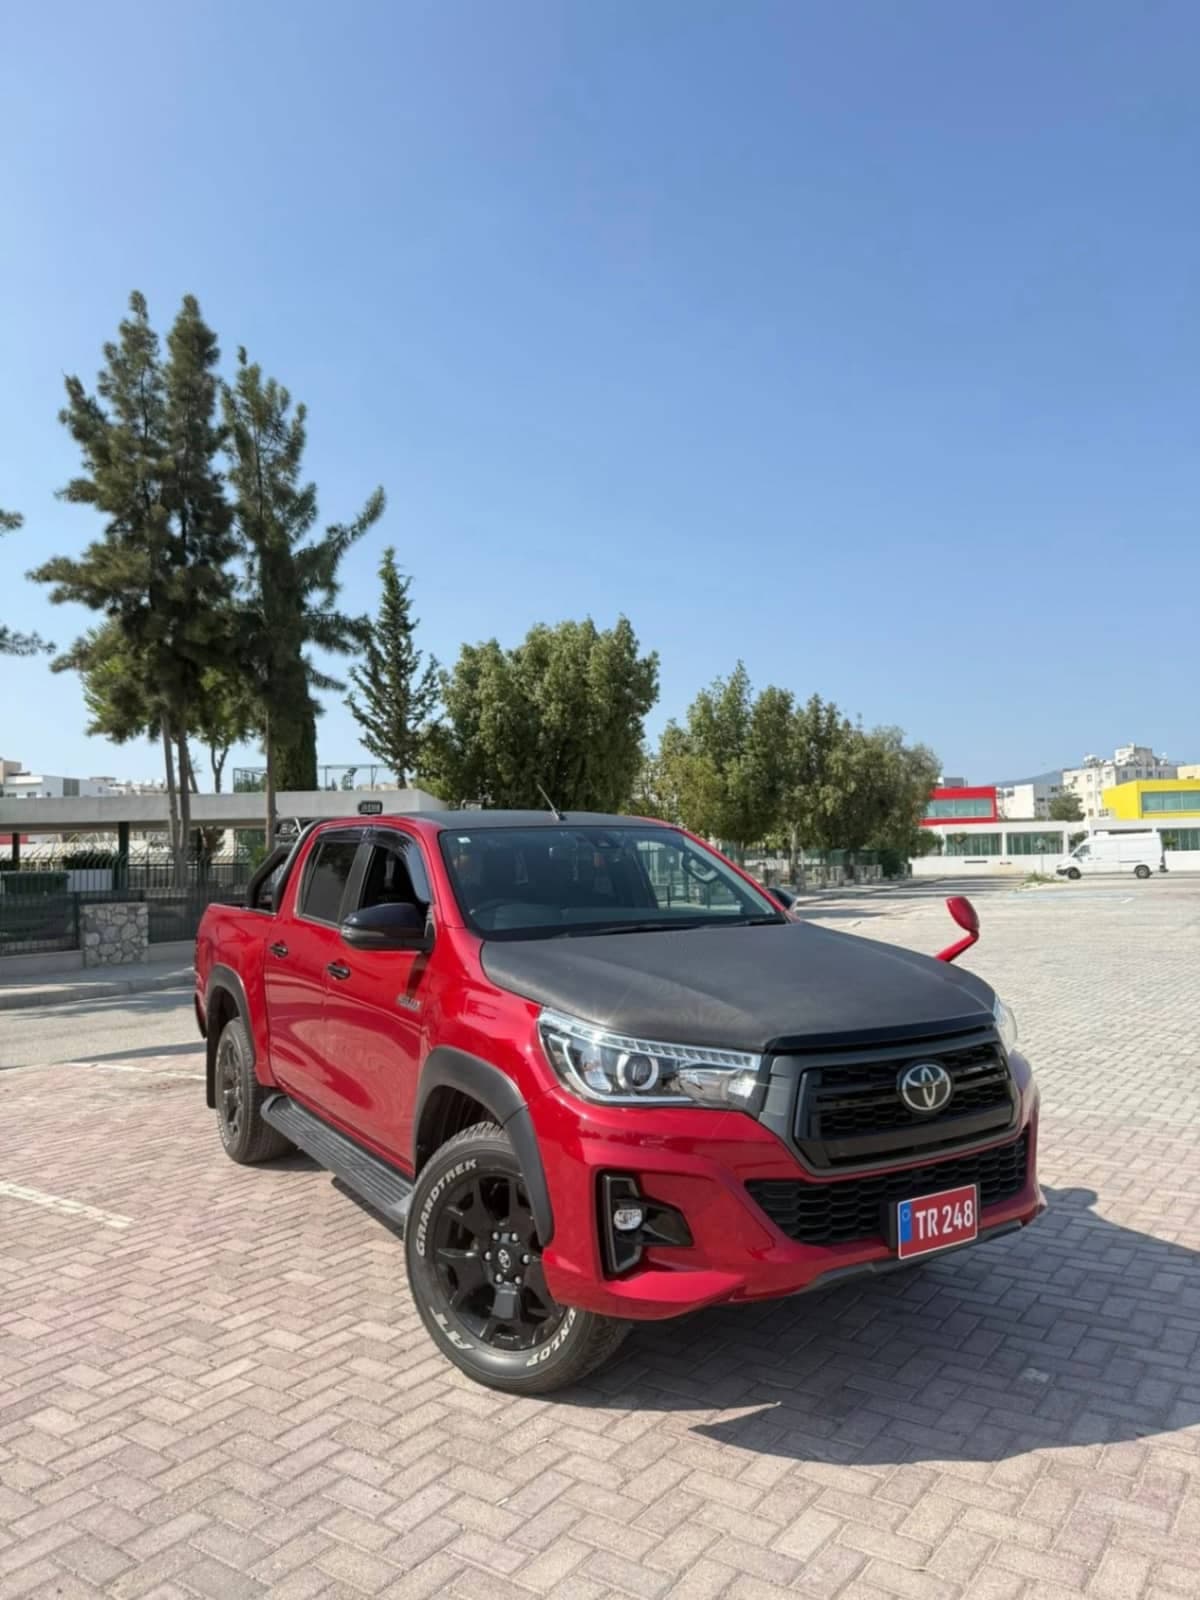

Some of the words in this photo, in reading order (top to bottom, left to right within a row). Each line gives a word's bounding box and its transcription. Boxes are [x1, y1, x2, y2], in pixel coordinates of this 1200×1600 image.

[416, 1158, 478, 1257] GRANDTREK
[915, 1208, 939, 1240] TR
[942, 1199, 974, 1235] 248
[526, 1307, 577, 1368] UNLOP
